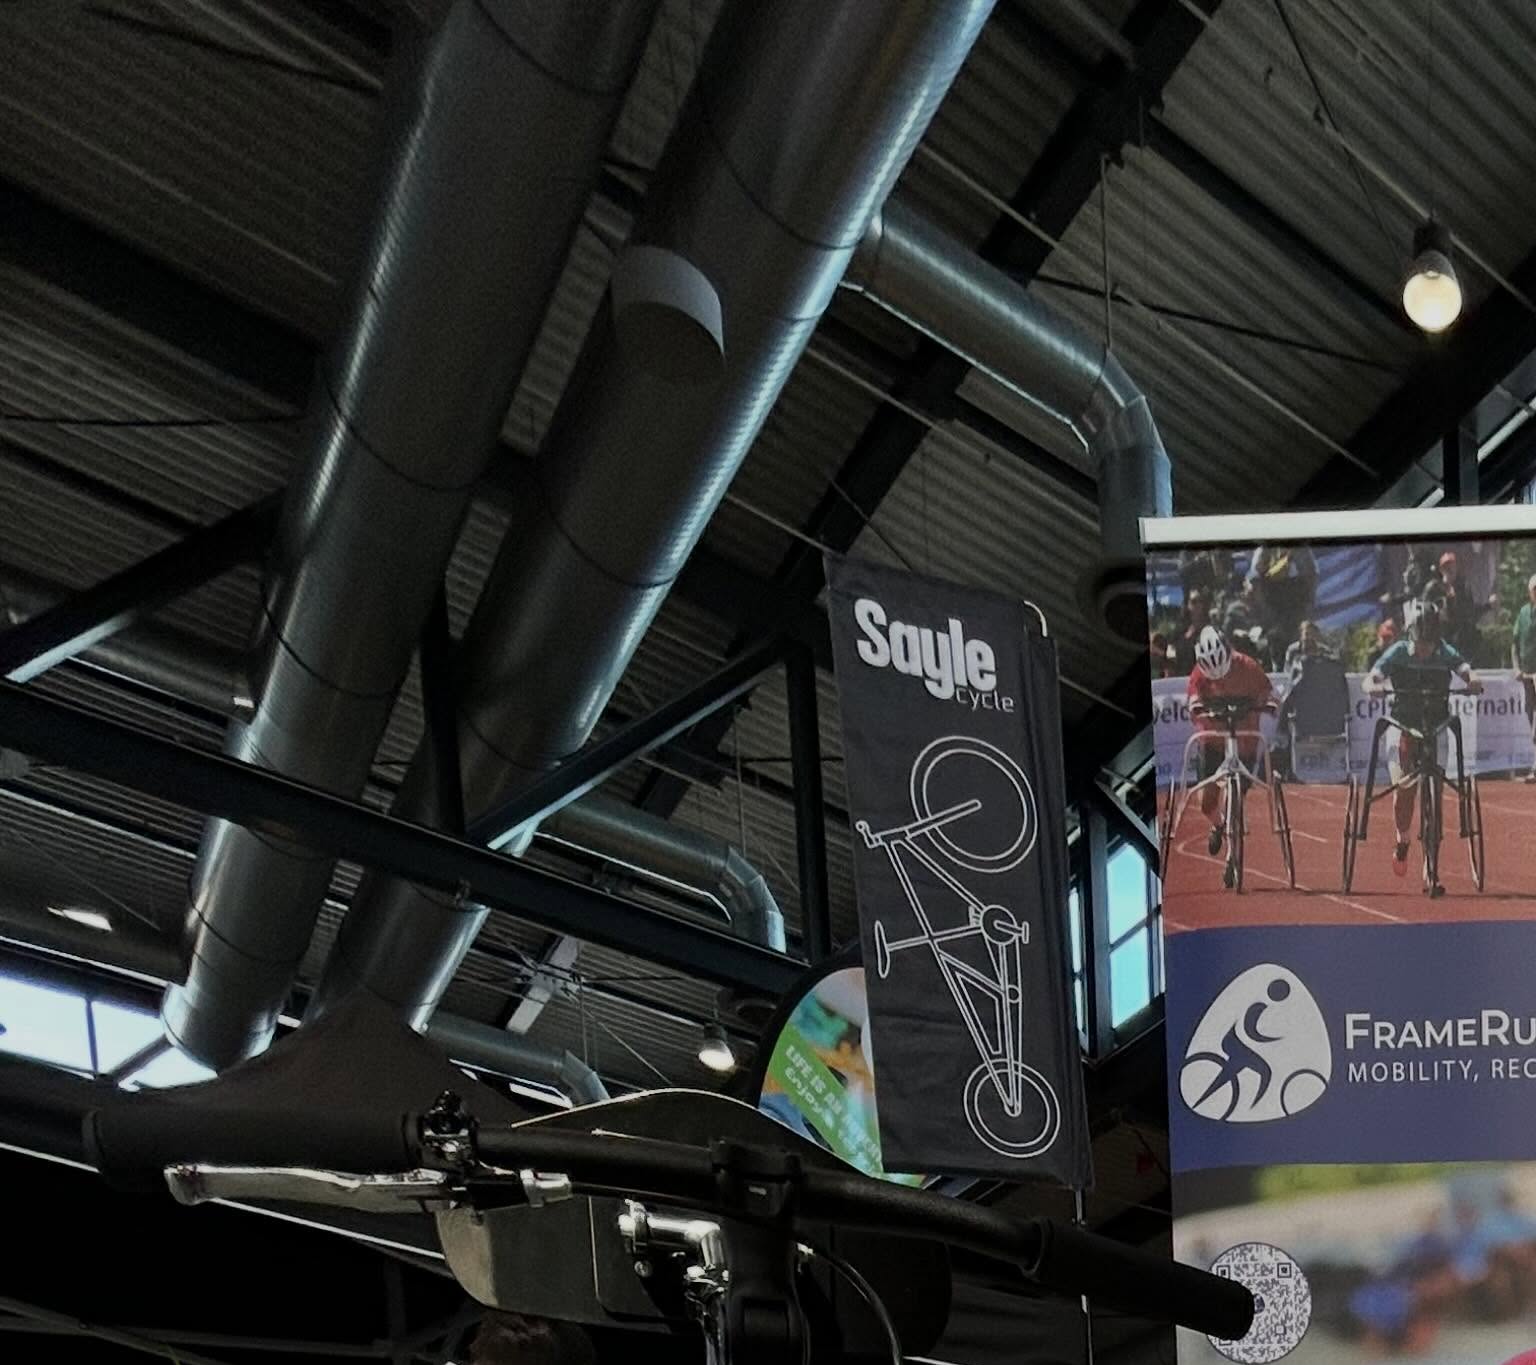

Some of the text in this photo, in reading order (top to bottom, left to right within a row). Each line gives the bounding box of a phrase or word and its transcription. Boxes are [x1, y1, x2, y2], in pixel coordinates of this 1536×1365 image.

[854, 598, 997, 700] Sayle
[956, 686, 1015, 713] cycle
[1348, 1059, 1479, 1084] MOBILITY,
